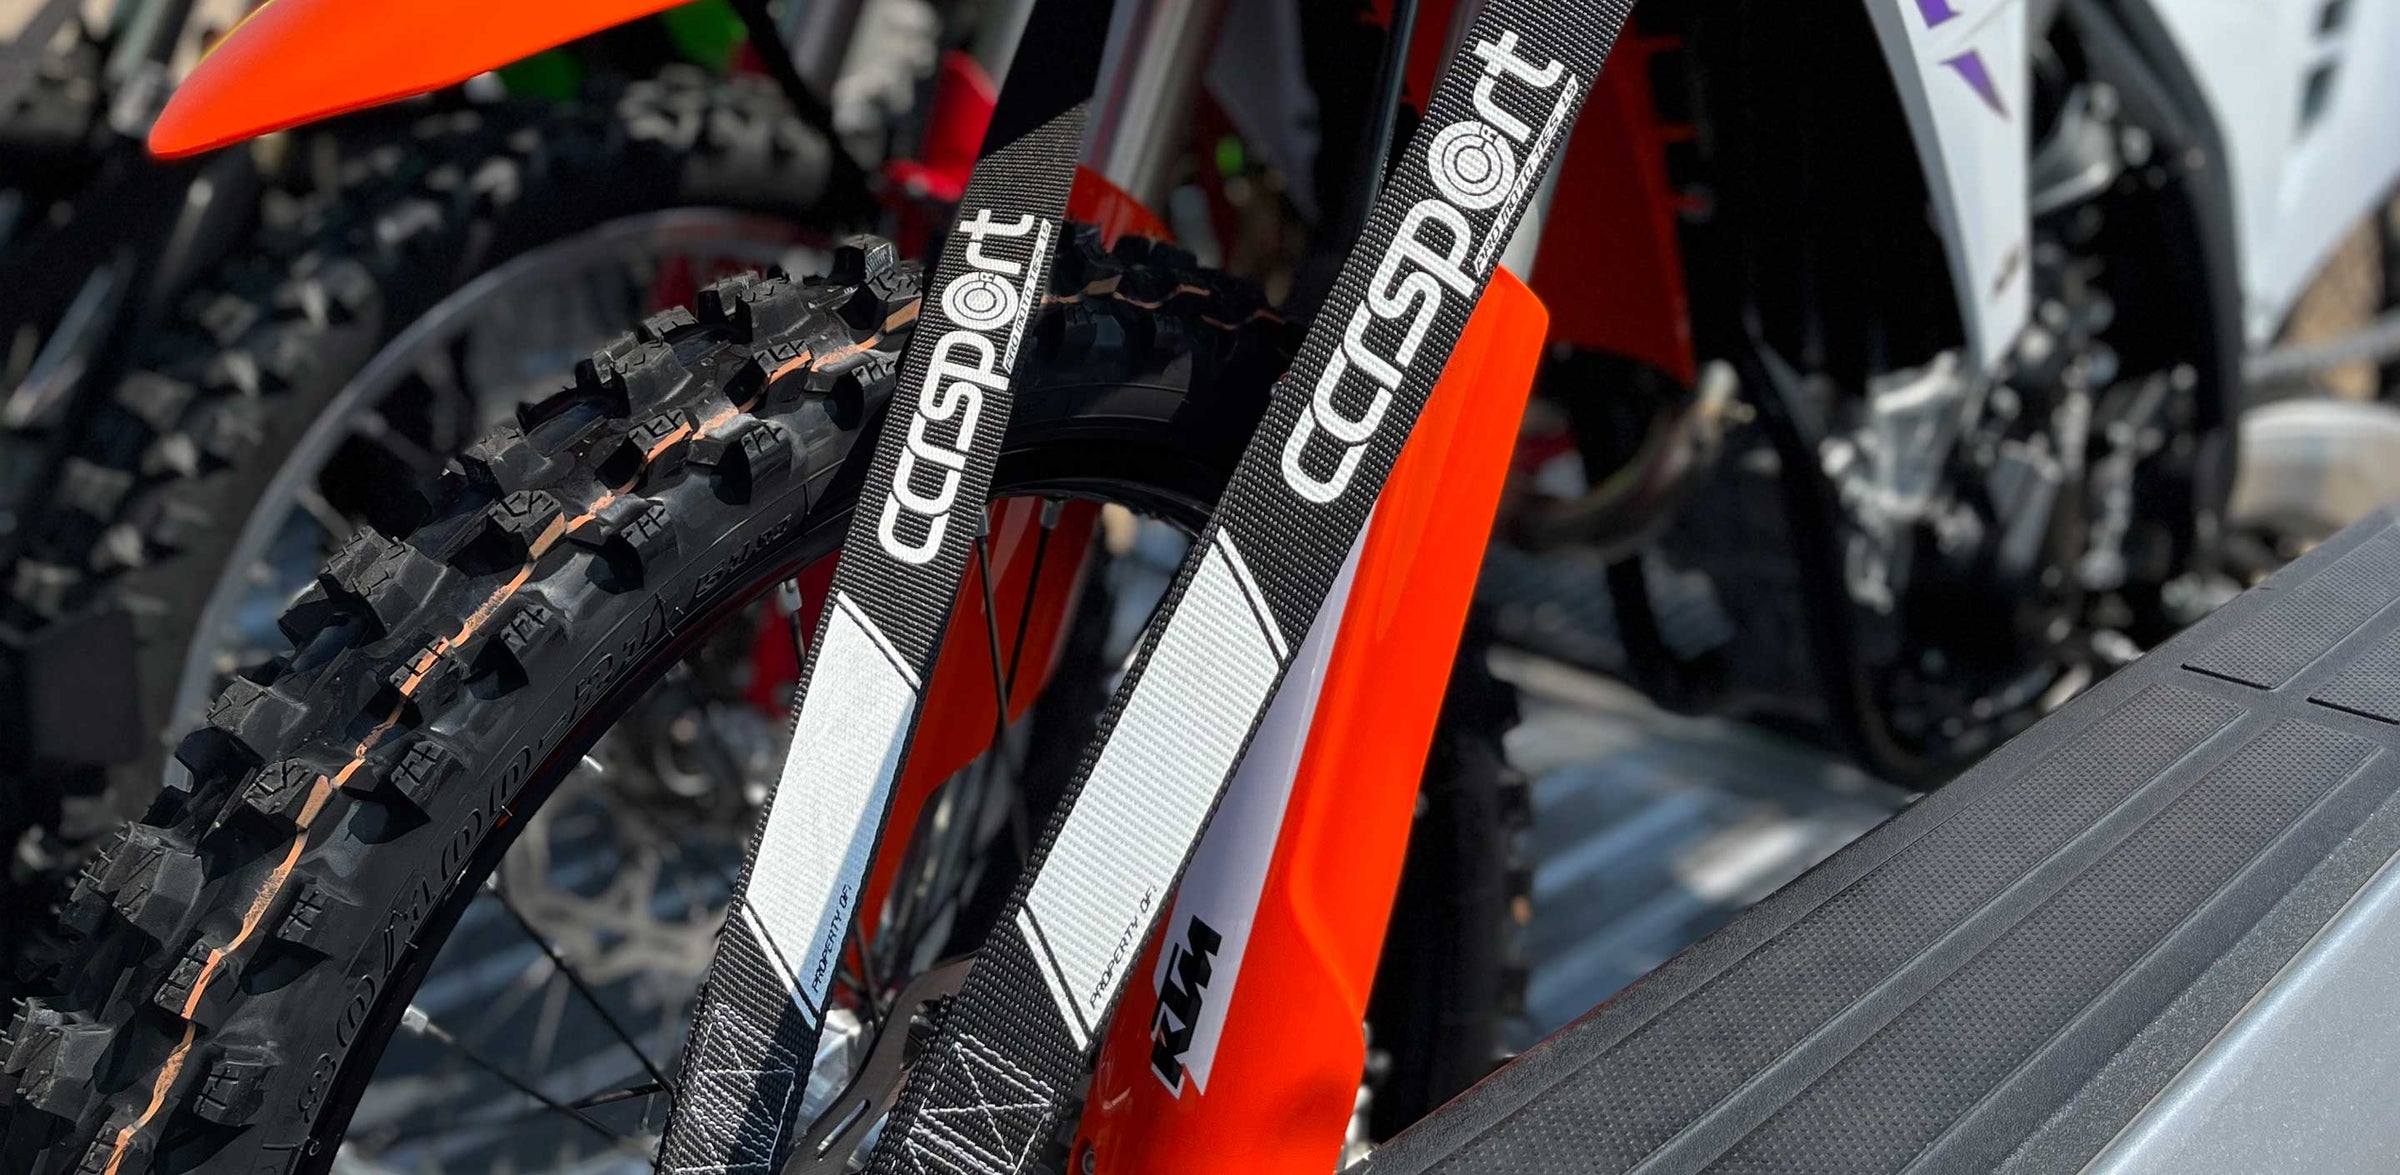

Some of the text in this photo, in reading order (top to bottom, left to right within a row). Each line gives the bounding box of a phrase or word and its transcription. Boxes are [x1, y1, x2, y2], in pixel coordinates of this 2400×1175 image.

[1476, 226, 1500, 273] PRO
[1501, 163, 1534, 224] MOTO
[1534, 113, 1559, 159] TIES
[1005, 336, 1019, 371] PRO
[1016, 287, 1033, 333] MOTO
[1029, 249, 1043, 285] TIES
[811, 909, 841, 993] PROPERTY
[1089, 915, 1138, 1010] PROPERTY
[1150, 914, 1223, 1090] KTM
